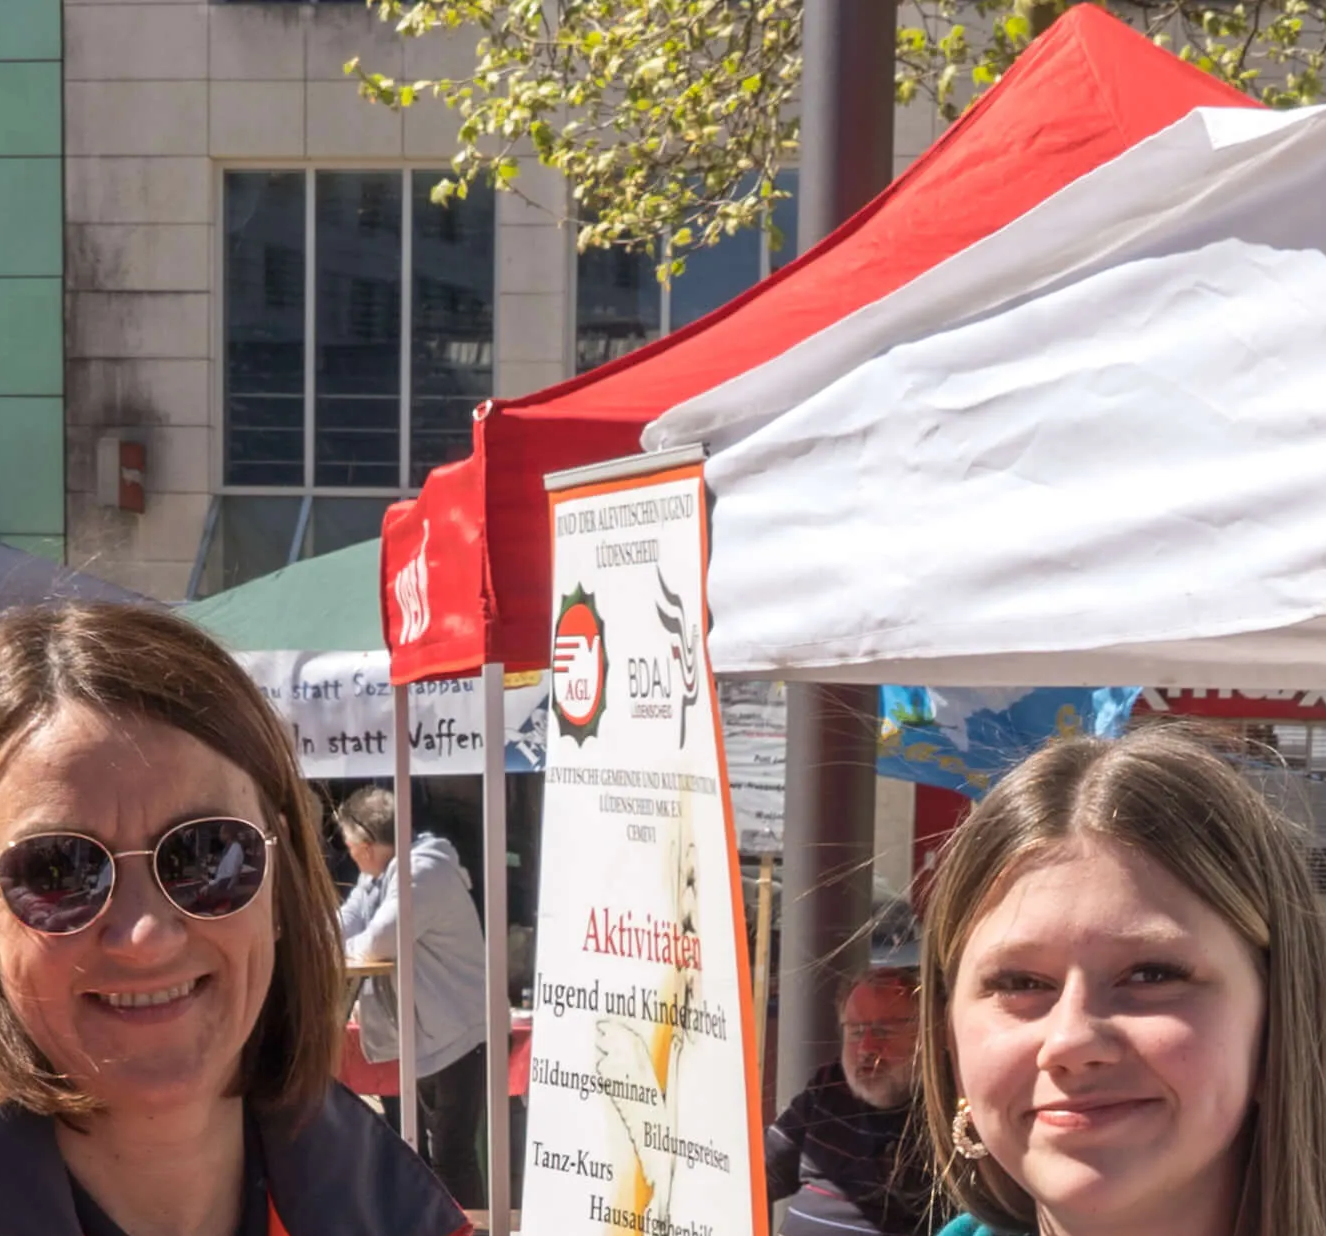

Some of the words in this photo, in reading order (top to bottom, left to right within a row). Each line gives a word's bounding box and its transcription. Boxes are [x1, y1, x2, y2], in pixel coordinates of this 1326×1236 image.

[291, 678, 343, 700] statt
[565, 678, 591, 701] AGL
[628, 656, 672, 698] BDAJ
[328, 724, 388, 755] statt
[582, 906, 703, 972] Aktivitäten
[536, 971, 600, 1018] Jugend
[605, 986, 637, 1018] und
[641, 986, 728, 1042] Kinderarbeit
[531, 1056, 659, 1107] Bildungsseminare
[533, 1140, 614, 1182] Tanz-Kurs
[643, 1120, 731, 1175] Bildungsreisen
